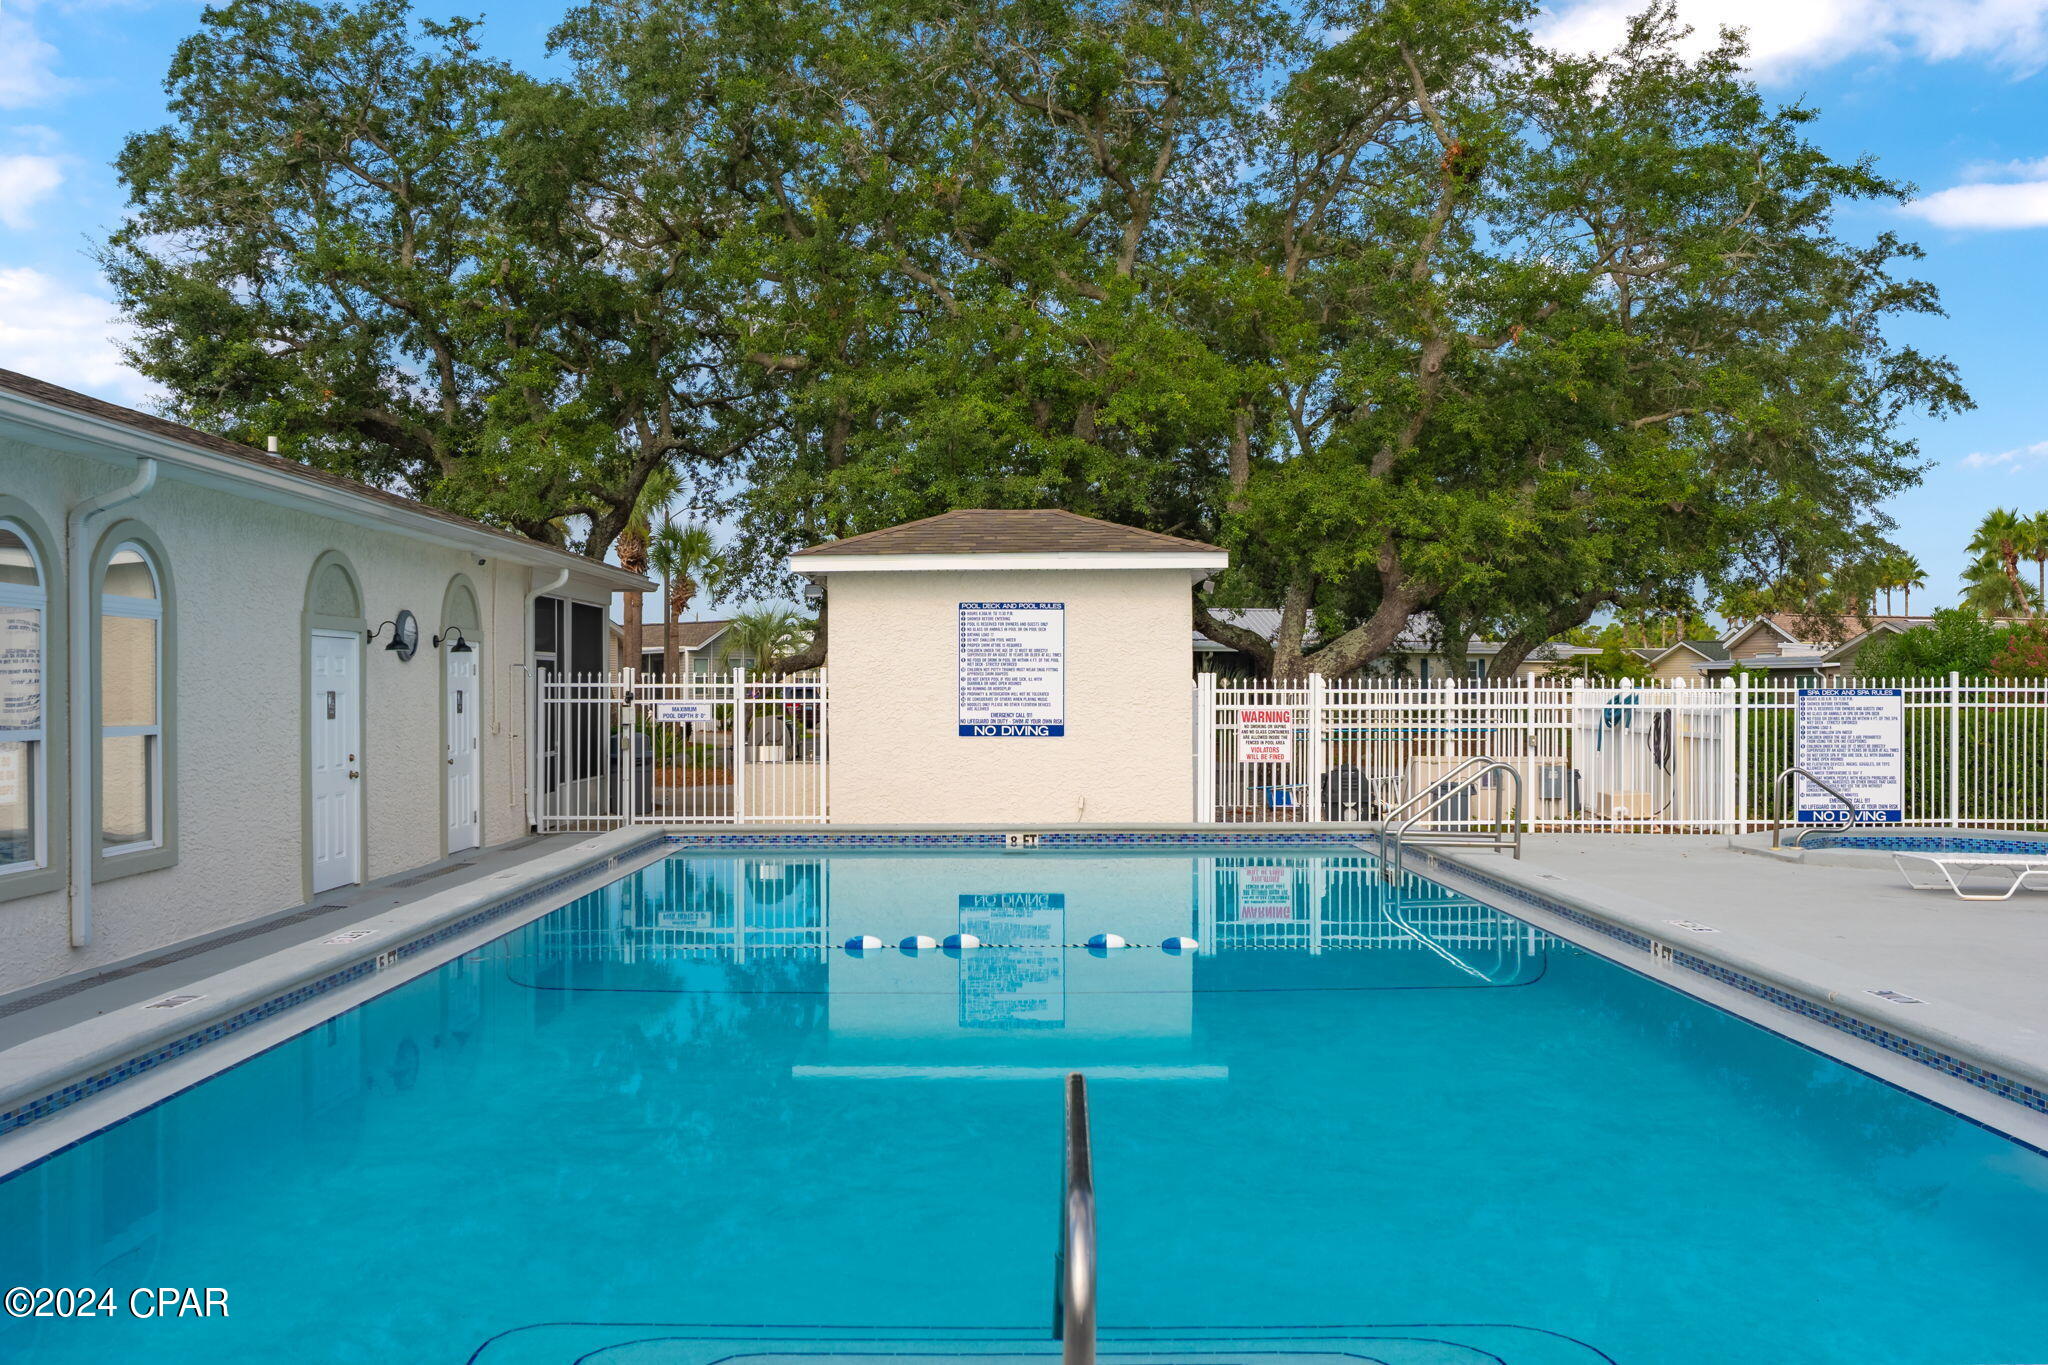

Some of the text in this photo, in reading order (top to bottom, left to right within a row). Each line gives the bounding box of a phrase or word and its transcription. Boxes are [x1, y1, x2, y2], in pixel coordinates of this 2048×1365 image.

[1241, 711, 1290, 722] WARNING
[974, 726, 1049, 736] NO DIVING
[1813, 811, 1886, 821] NO DVING
